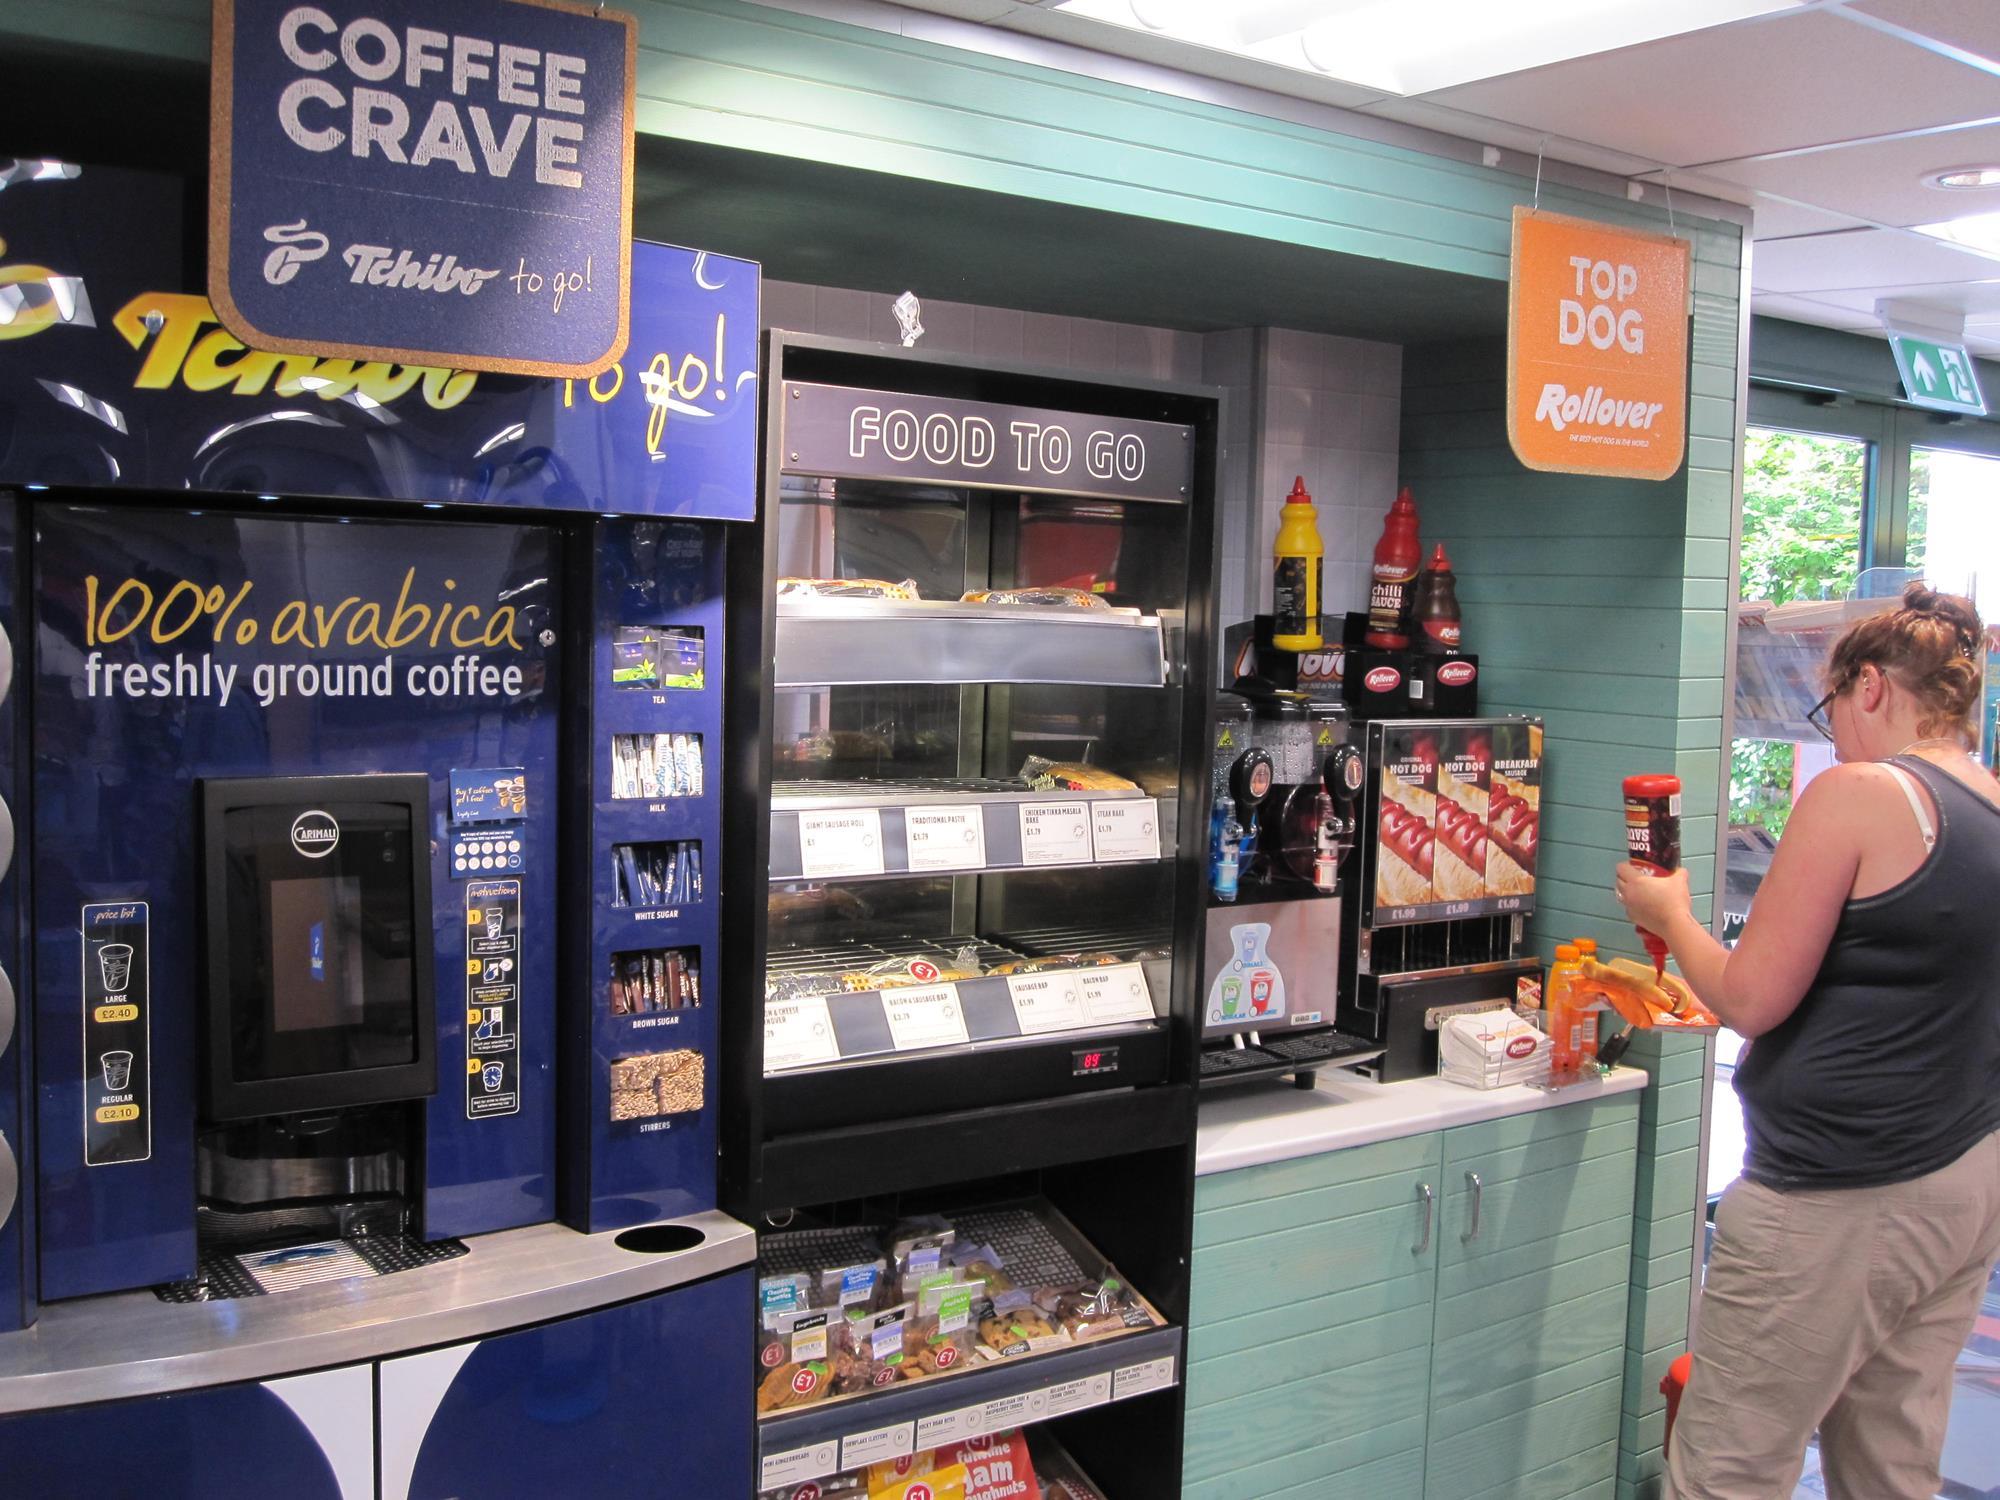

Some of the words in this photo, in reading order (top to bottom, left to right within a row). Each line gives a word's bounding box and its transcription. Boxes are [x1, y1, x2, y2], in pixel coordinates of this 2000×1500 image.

[279, 6, 586, 115] COFFEE
[278, 77, 584, 188] CRAVE
[342, 244, 500, 295] Tchibo
[509, 257, 543, 294] to
[553, 255, 593, 314] go!
[1569, 255, 1639, 301] TOP
[1558, 299, 1645, 354] DOG
[645, 313, 727, 456] go!
[1535, 383, 1664, 432] Rollover
[848, 406, 996, 468] FOOD
[1009, 421, 1072, 475] TO
[1085, 430, 1146, 481] GO
[1569, 434, 1579, 442] THE
[1591, 436, 1603, 444] HOT
[1602, 437, 1615, 445] DOG
[1372, 584, 1403, 597] chilli
[85, 574, 257, 647] 100%
[271, 566, 524, 650] arabica
[1371, 596, 1401, 609] SAUCE
[1442, 668, 1471, 679] Rollover
[85, 652, 238, 707] freshly
[253, 655, 394, 707] ground
[407, 655, 524, 697] coffee
[1369, 674, 1396, 685] Rollover
[652, 696, 666, 704] TEA
[1390, 765, 1409, 774] HOT
[1411, 764, 1432, 774] DOG
[1445, 762, 1464, 772] HOT
[1466, 762, 1485, 771] DOG
[1495, 760, 1538, 769] BREAKFAST
[650, 804, 666, 812] MILK
[1025, 809, 1046, 817] CHICKEN
[806, 821, 823, 829] GIANT
[824, 820, 850, 829] SAUSAGE
[850, 820, 864, 828] ROLL
[912, 816, 947, 825] TRADITIONAL
[294, 826, 337, 842] CARIMALI
[913, 833, 928, 841] £1.79
[1027, 828, 1041, 836] £1.79
[471, 885, 516, 897] instructions
[1446, 903, 1469, 914] £1.99
[1498, 899, 1520, 909] £1.99
[95, 910, 118, 925] price
[120, 907, 136, 919] list
[635, 911, 655, 920] WHITE
[656, 910, 679, 919] SUGAR
[915, 963, 934, 979] £1
[1015, 983, 1037, 992] SAUSAGE
[105, 994, 127, 1003] LARGE
[913, 995, 936, 1004] SAUSAGE
[102, 1008, 131, 1019] £2.40
[778, 1006, 799, 1015] CHEESE
[633, 1018, 656, 1029] BROWN
[657, 1016, 679, 1026] SUGAR
[101, 1094, 133, 1104] REGULAR
[104, 1108, 132, 1119] £2.10
[640, 1121, 671, 1133] STIRRERS
[765, 1348, 780, 1361] £1
[939, 1352, 953, 1363] £1
[796, 1374, 812, 1387] £1
[877, 1371, 891, 1382] £1
[965, 1481, 1027, 1500] oughnuts
